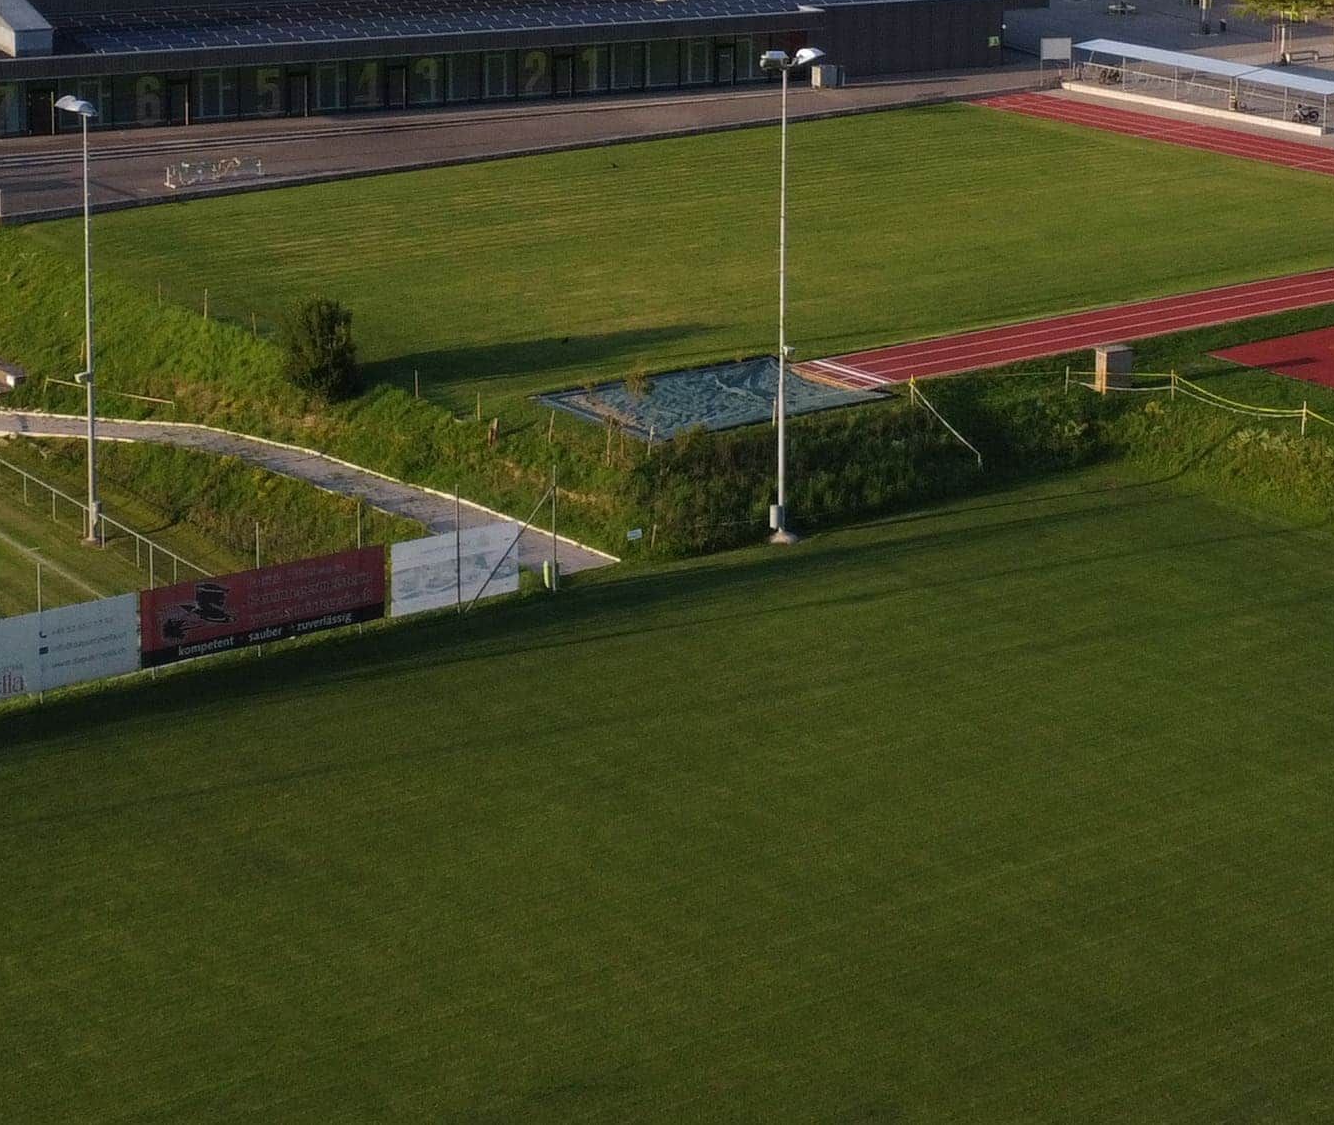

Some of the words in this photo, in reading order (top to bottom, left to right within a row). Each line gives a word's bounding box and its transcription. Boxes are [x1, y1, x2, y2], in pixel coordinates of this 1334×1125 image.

[257, 68, 281, 115] 5
[524, 51, 548, 94] 2
[136, 76, 161, 125] 6
[178, 636, 235, 656] kompetent
[248, 627, 282, 641] sauber
[297, 612, 353, 632] zuverlässig
